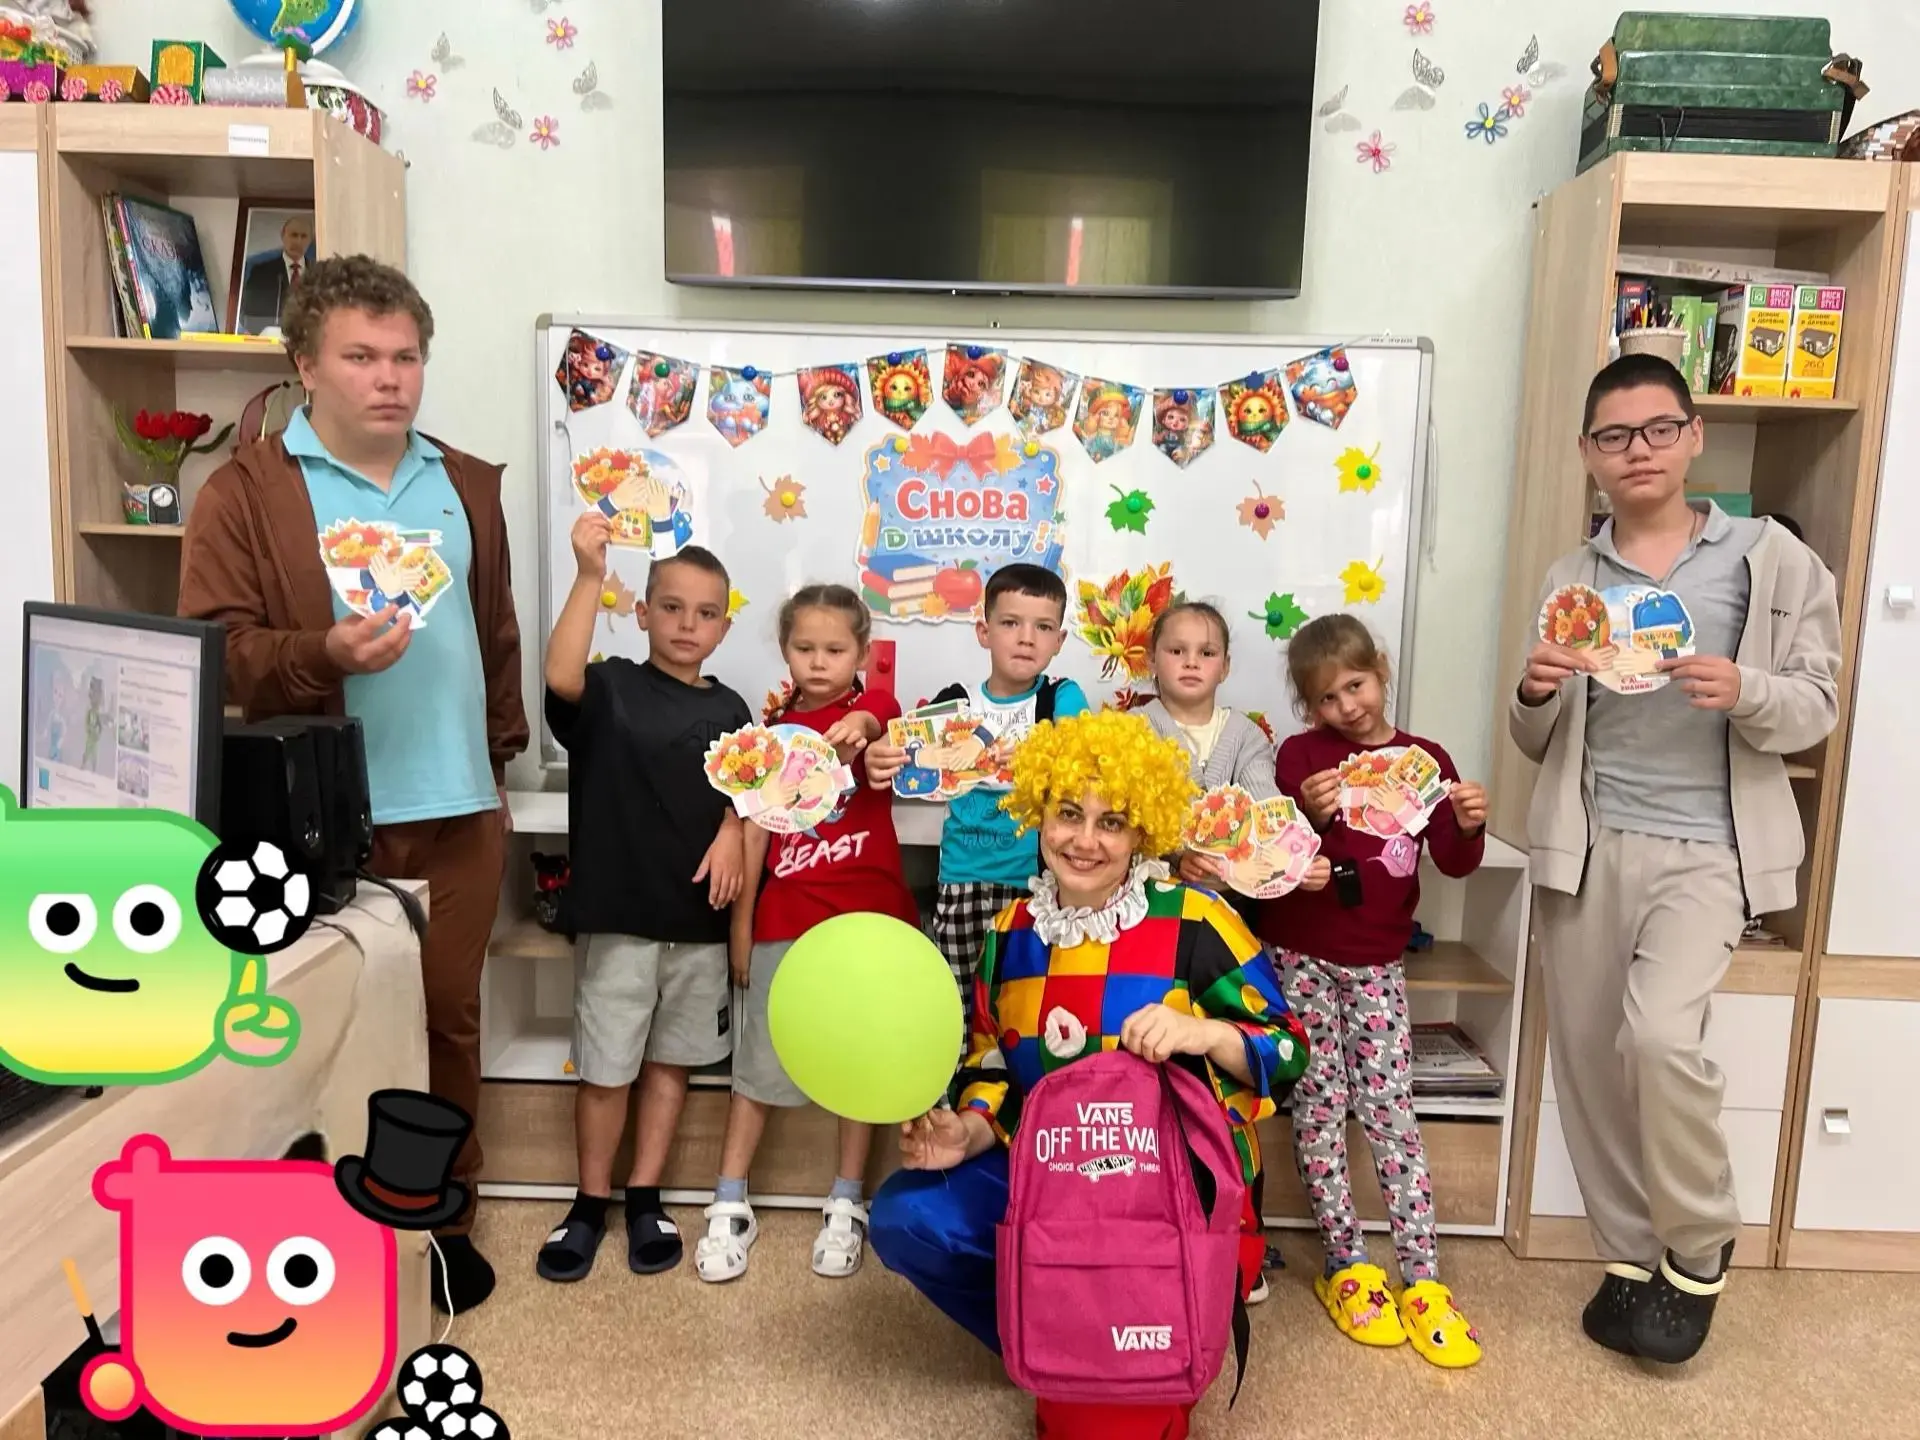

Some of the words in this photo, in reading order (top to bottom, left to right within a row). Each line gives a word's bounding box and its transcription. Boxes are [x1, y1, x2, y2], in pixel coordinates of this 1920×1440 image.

[1769, 298, 1790, 307] STYLE
[1770, 289, 1791, 298] BRICK
[1821, 290, 1841, 299] BRICK
[1820, 300, 1841, 309] STYLE
[774, 830, 870, 879] BEAST
[1390, 839, 1408, 860] M
[1076, 1102, 1133, 1126] VANS
[1036, 1127, 1073, 1163] OFF
[1076, 1126, 1121, 1152] THE
[1111, 1325, 1173, 1352] VANS
